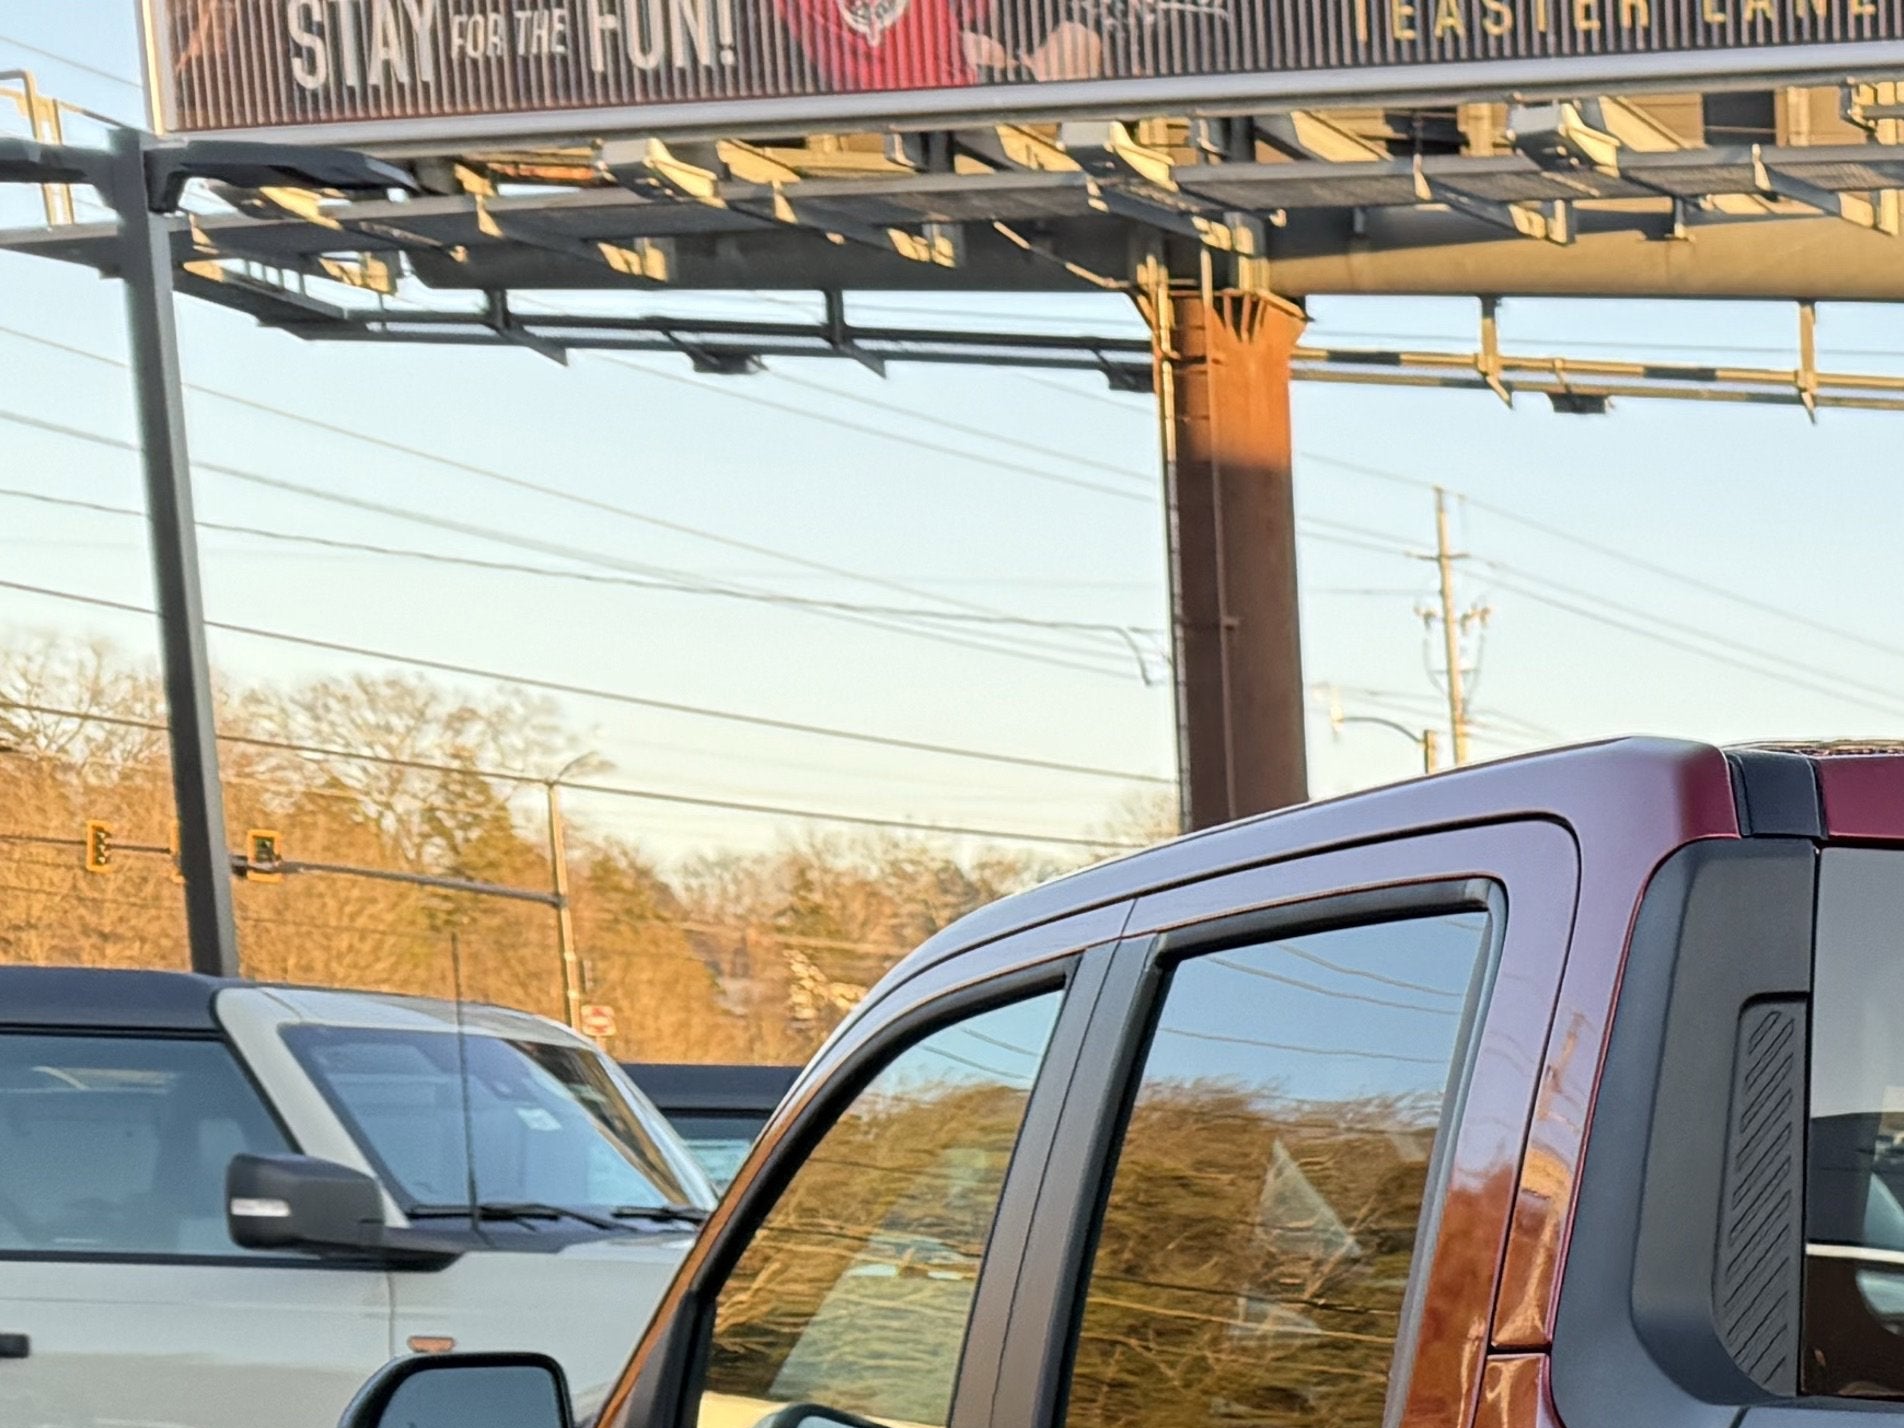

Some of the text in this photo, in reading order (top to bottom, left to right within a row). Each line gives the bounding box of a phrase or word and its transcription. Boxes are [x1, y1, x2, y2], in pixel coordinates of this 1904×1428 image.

[287, 0, 738, 90] STAY FOR THE FUN!
